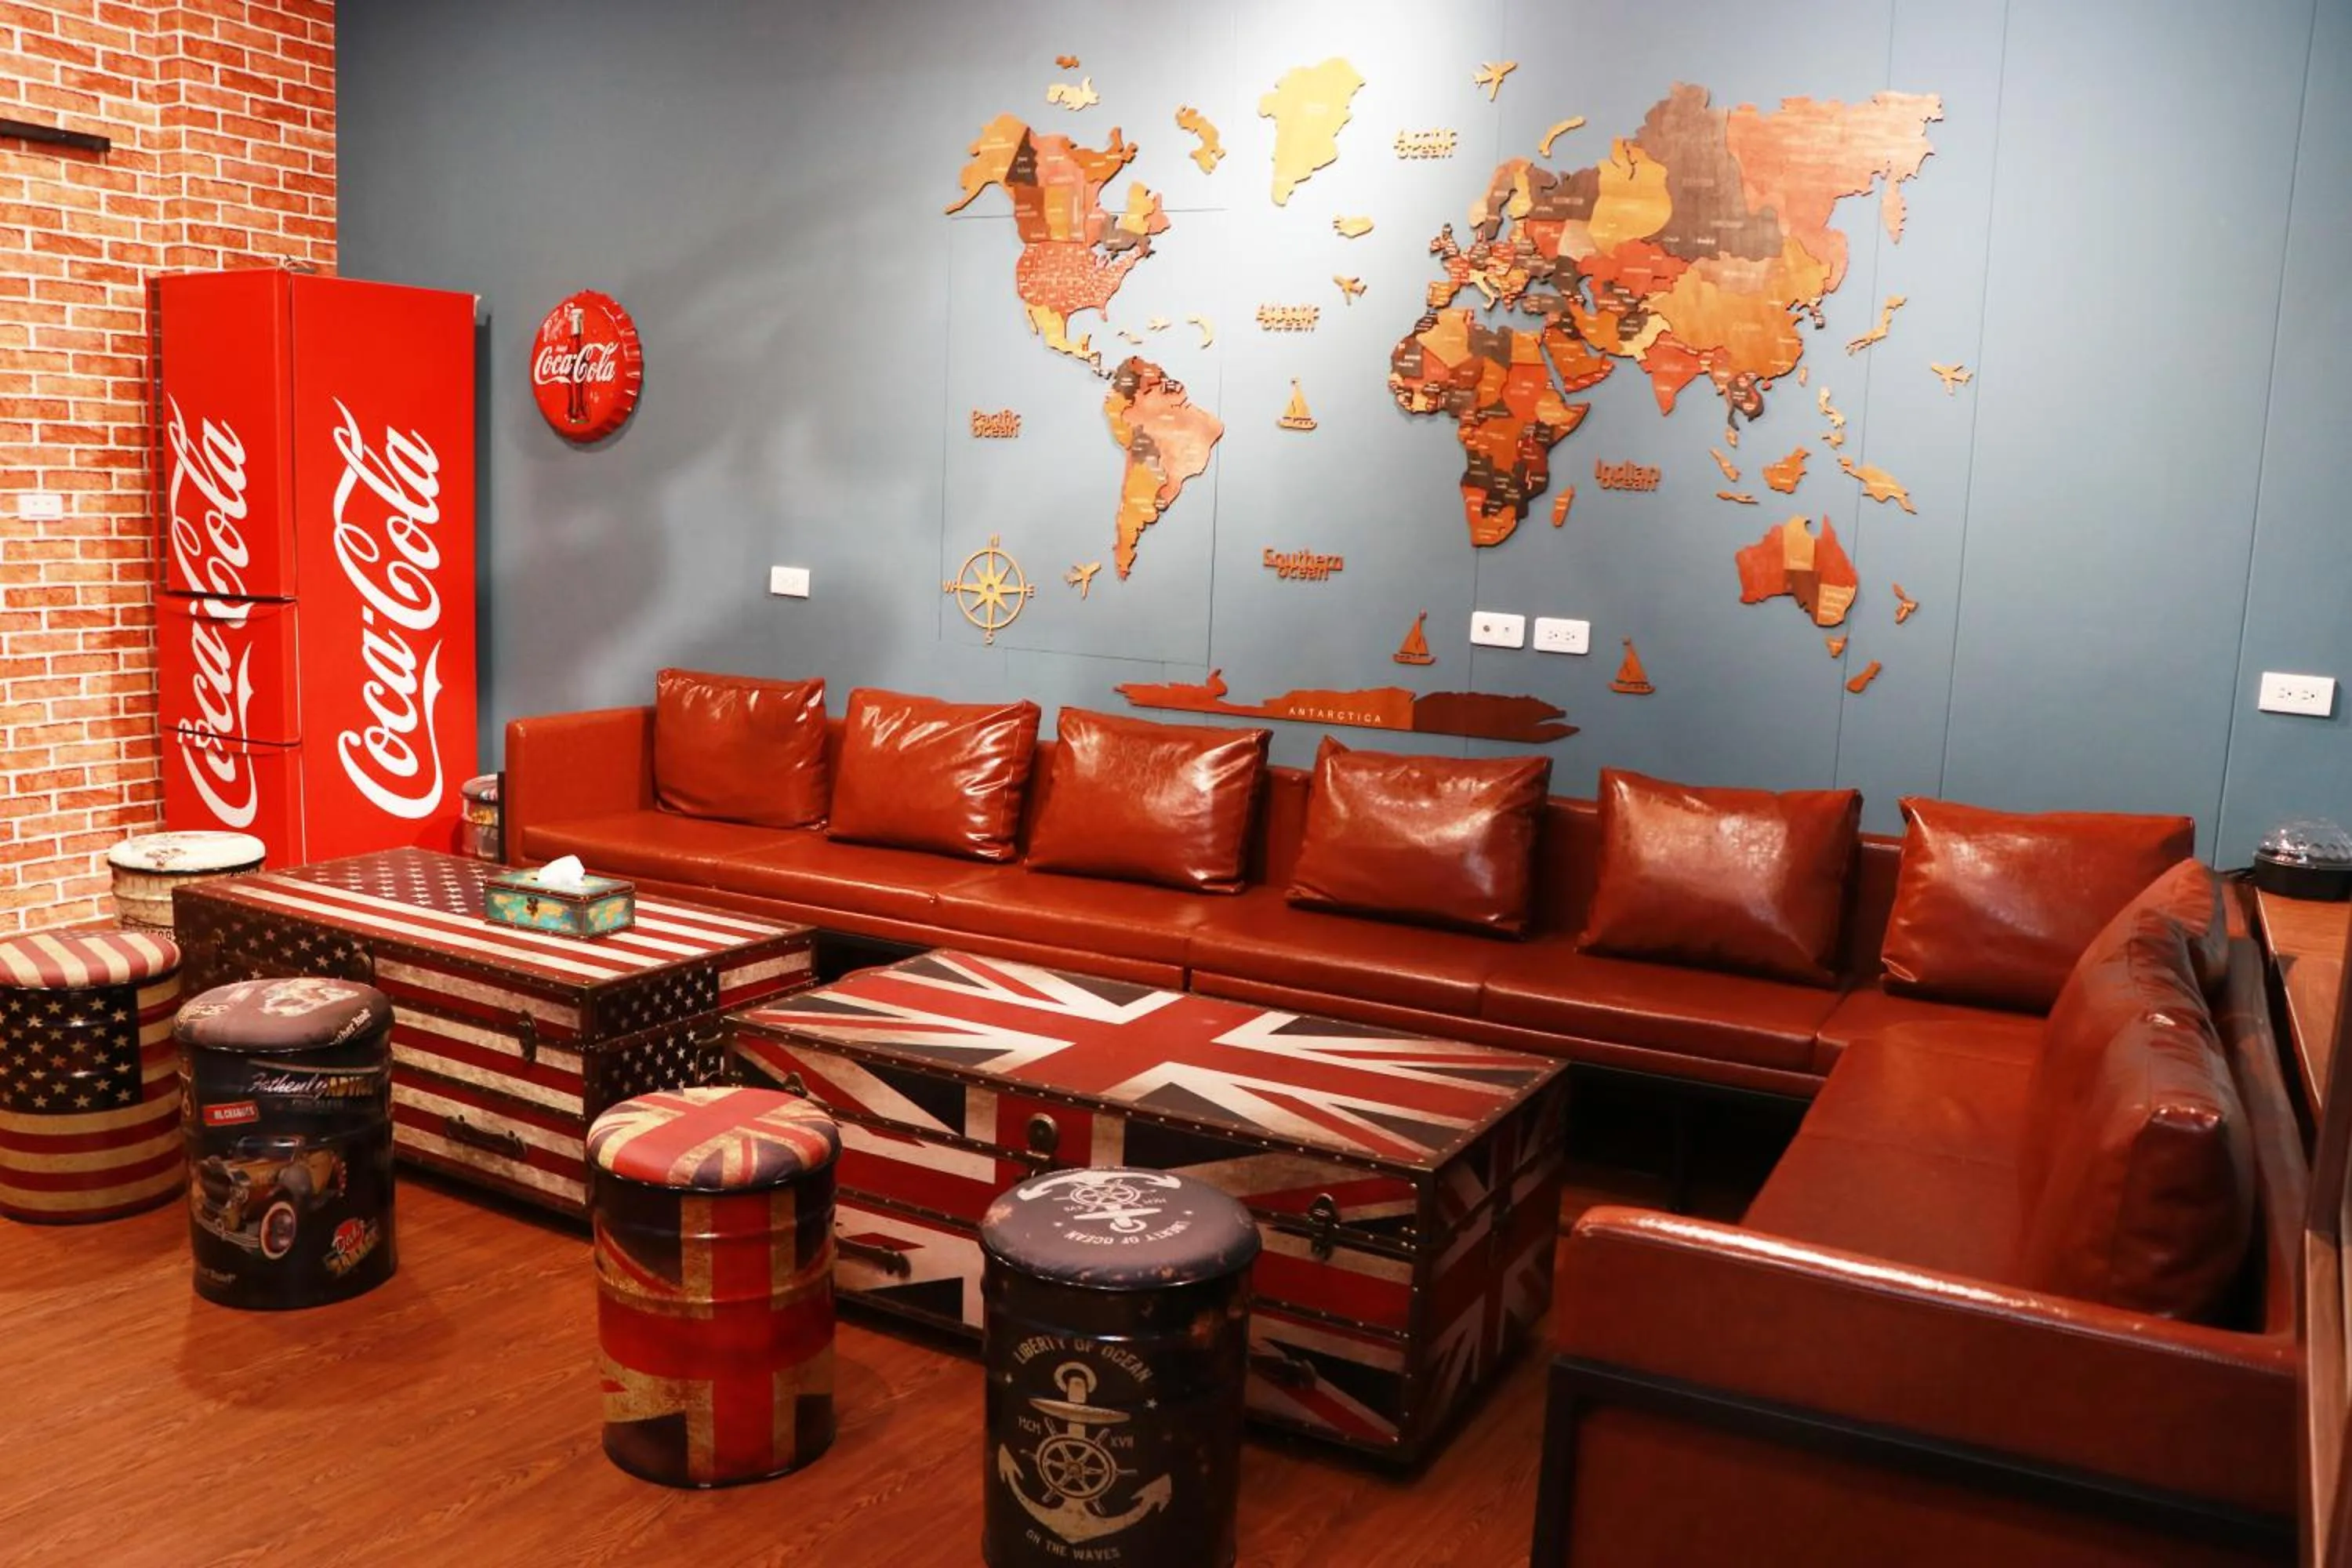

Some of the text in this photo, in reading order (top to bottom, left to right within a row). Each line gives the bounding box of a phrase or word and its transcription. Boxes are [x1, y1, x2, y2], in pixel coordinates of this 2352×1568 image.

[1263, 547, 1344, 572] Southern
[333, 396, 444, 820] Coca-Cola
[1288, 707, 1381, 724] ANTARCTICA
[1013, 1334, 1154, 1383] LIBERTY OF OCEAN
[1025, 1529, 1041, 1544] ON
[1046, 1539, 1067, 1557] THE
